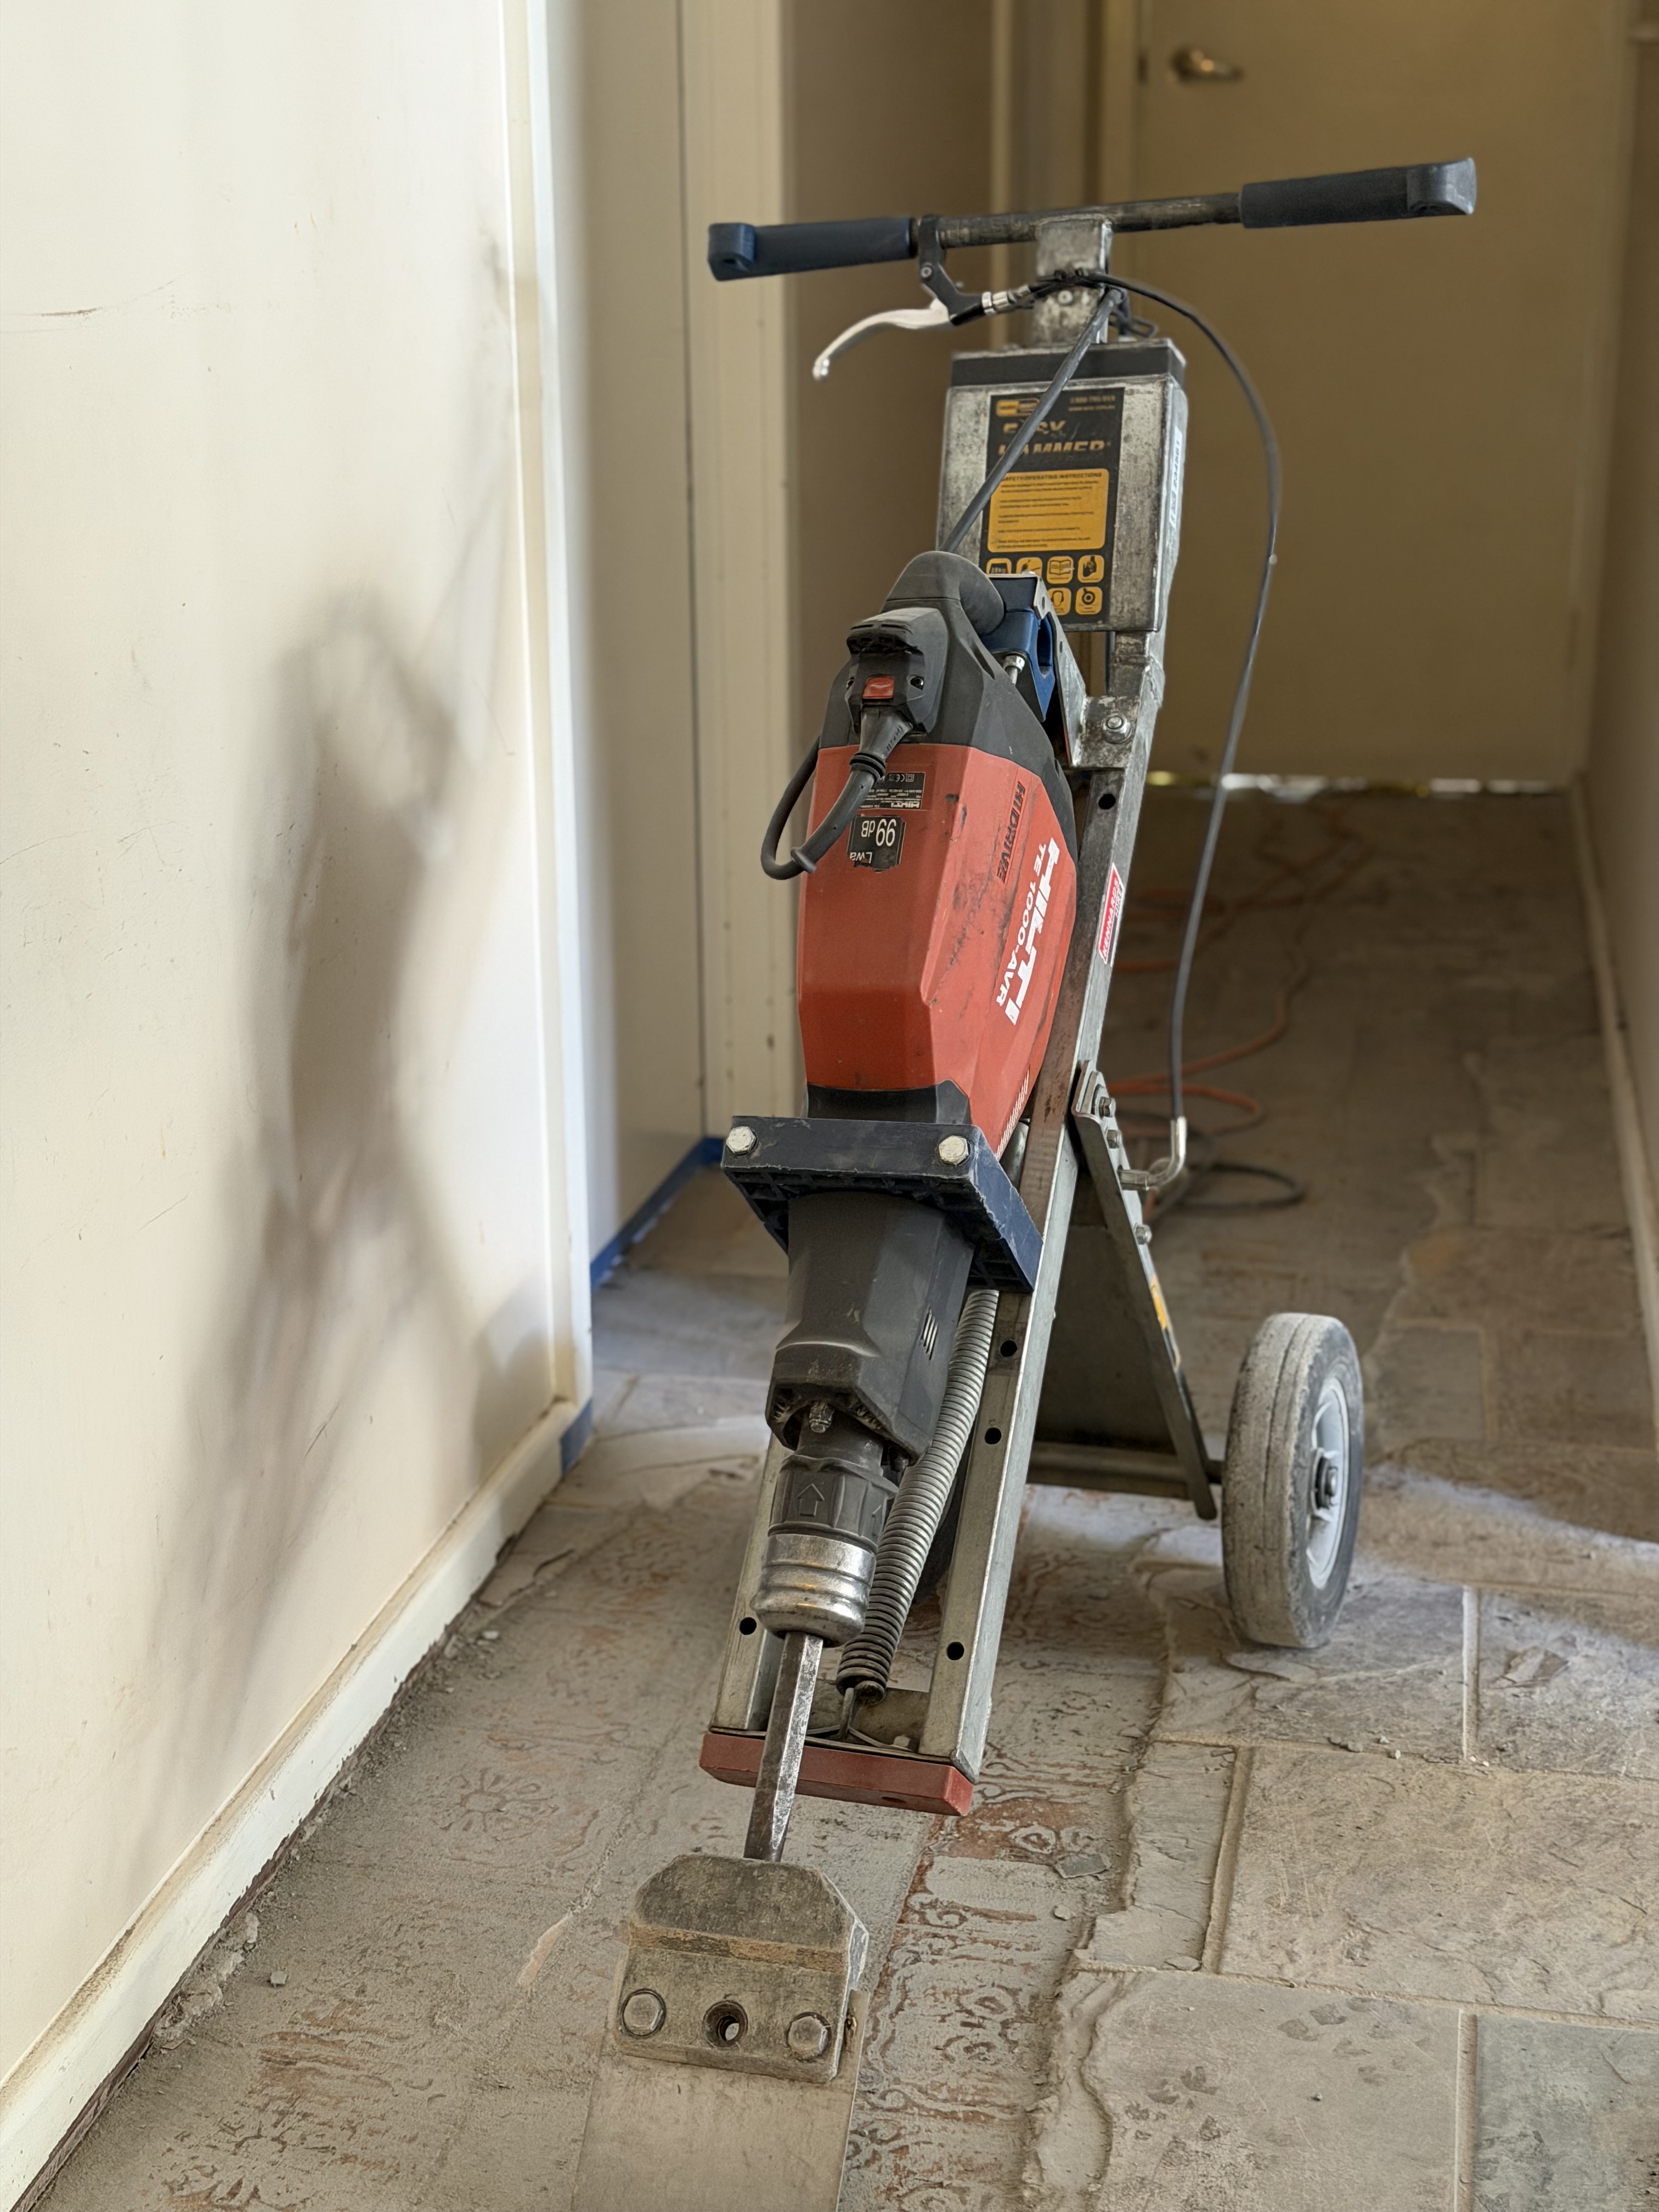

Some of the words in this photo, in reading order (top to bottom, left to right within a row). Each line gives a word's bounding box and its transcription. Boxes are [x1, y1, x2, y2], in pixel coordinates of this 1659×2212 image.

[1003, 420, 1066, 434] ESY
[861, 820, 876, 838] dB
[876, 819, 897, 847] 99
[997, 781, 1026, 884] HIDRIVE
[850, 851, 873, 864] Lwa
[1032, 843, 1047, 876] TE
[1005, 838, 1060, 1025] HILTI
[1102, 877, 1119, 958] KENNARDS
[995, 881, 1036, 1007] 1000-AVR
